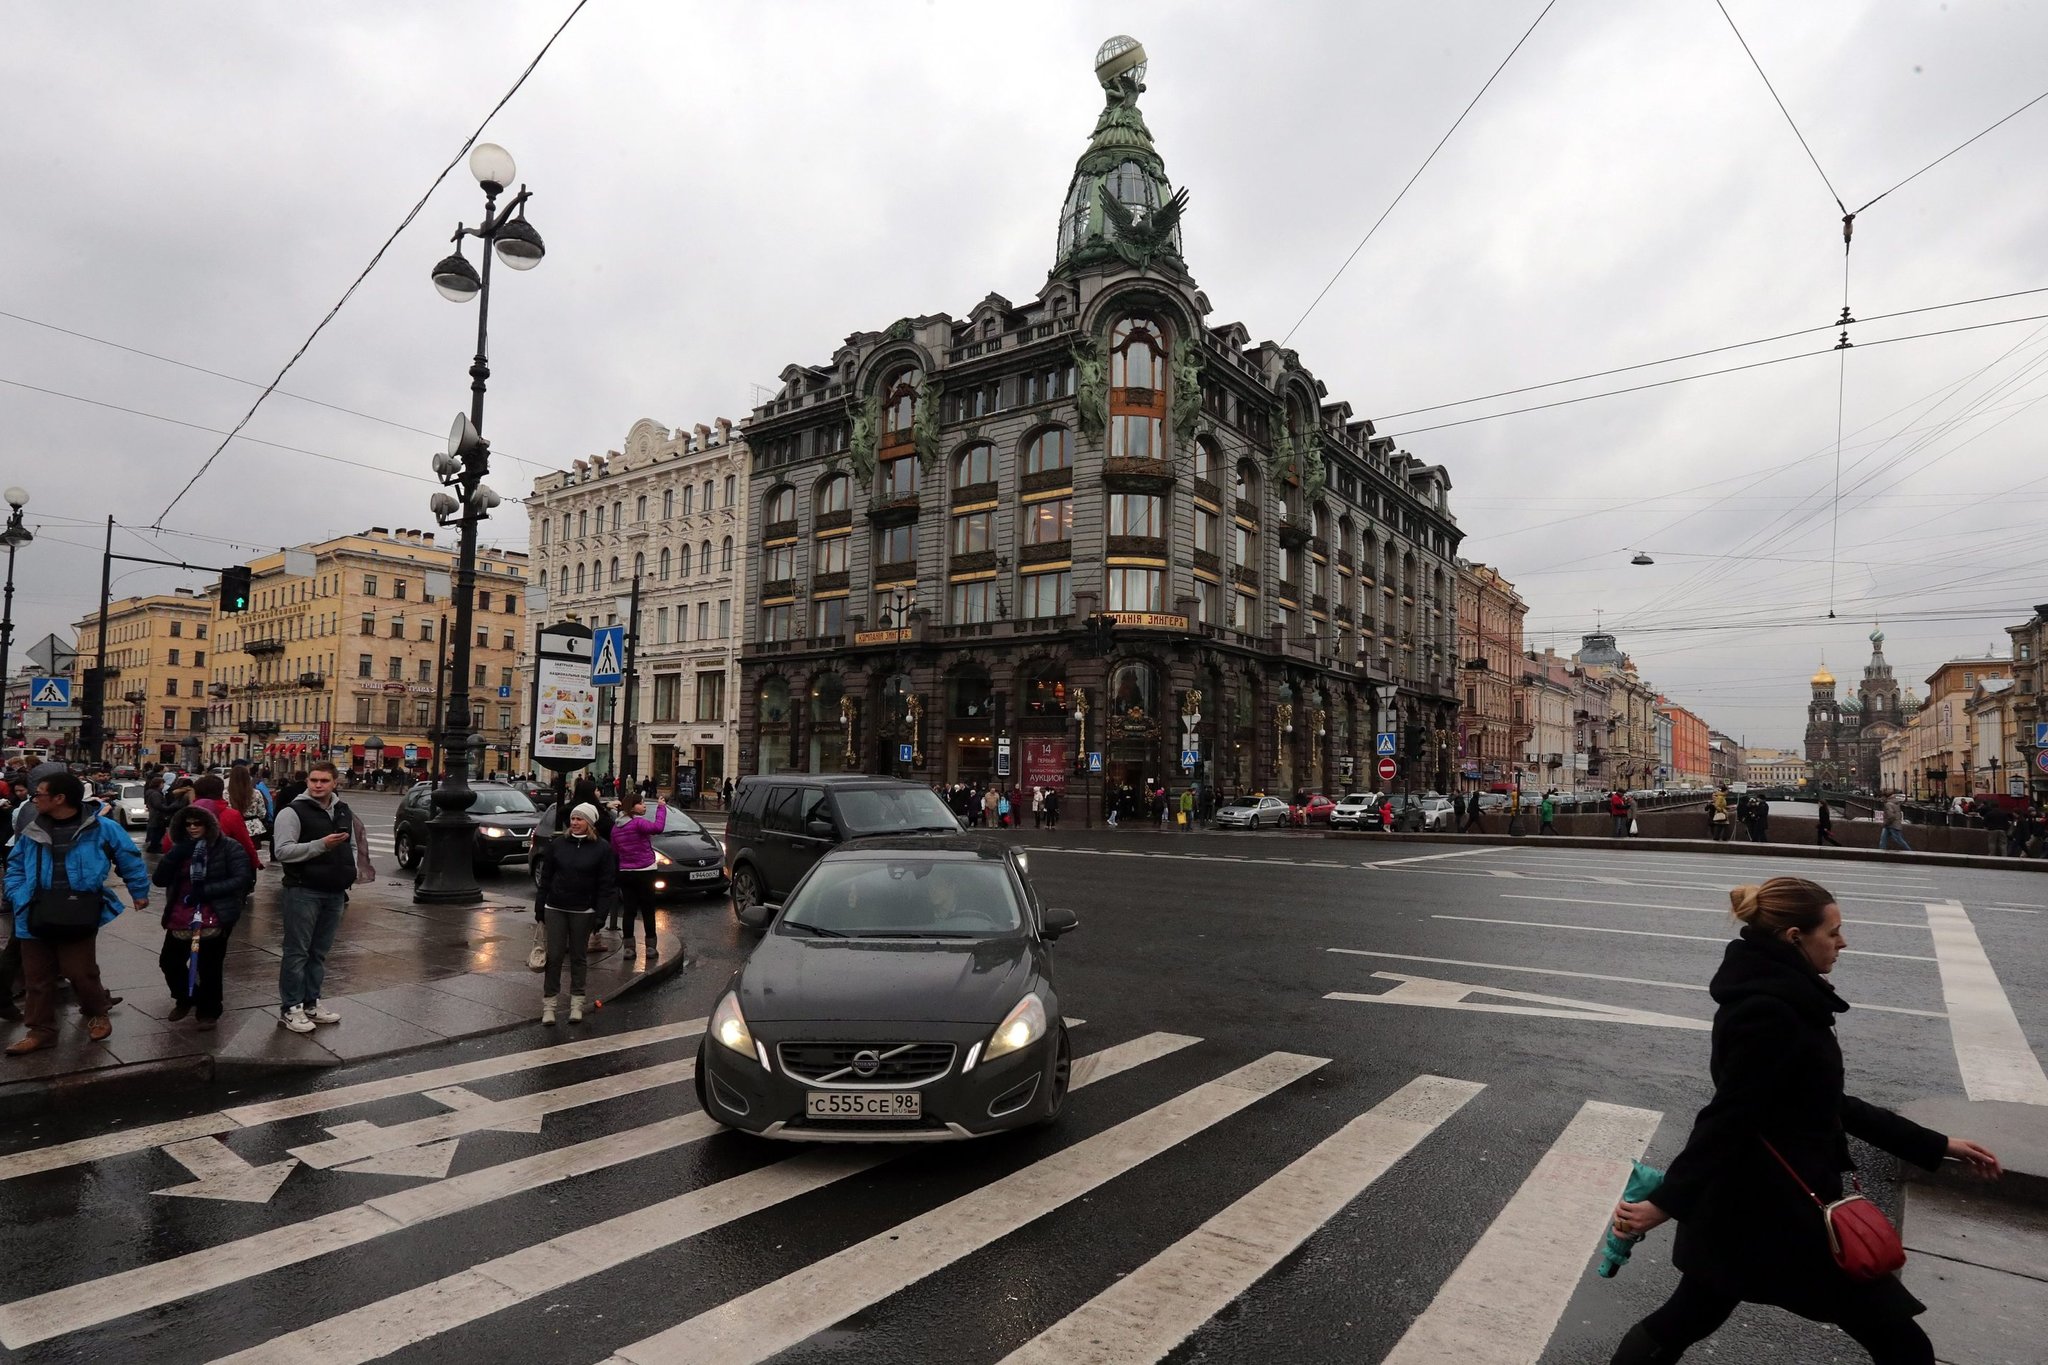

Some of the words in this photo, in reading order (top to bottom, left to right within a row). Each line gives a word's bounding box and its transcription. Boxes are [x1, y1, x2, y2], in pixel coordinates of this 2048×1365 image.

[1148, 615, 1184, 627] ЗИНГЕРЪ
[886, 630, 909, 640] ЗИНГРЪ
[1042, 744, 1051, 754] 14
[1030, 774, 1065, 782] АУКЦИОН
